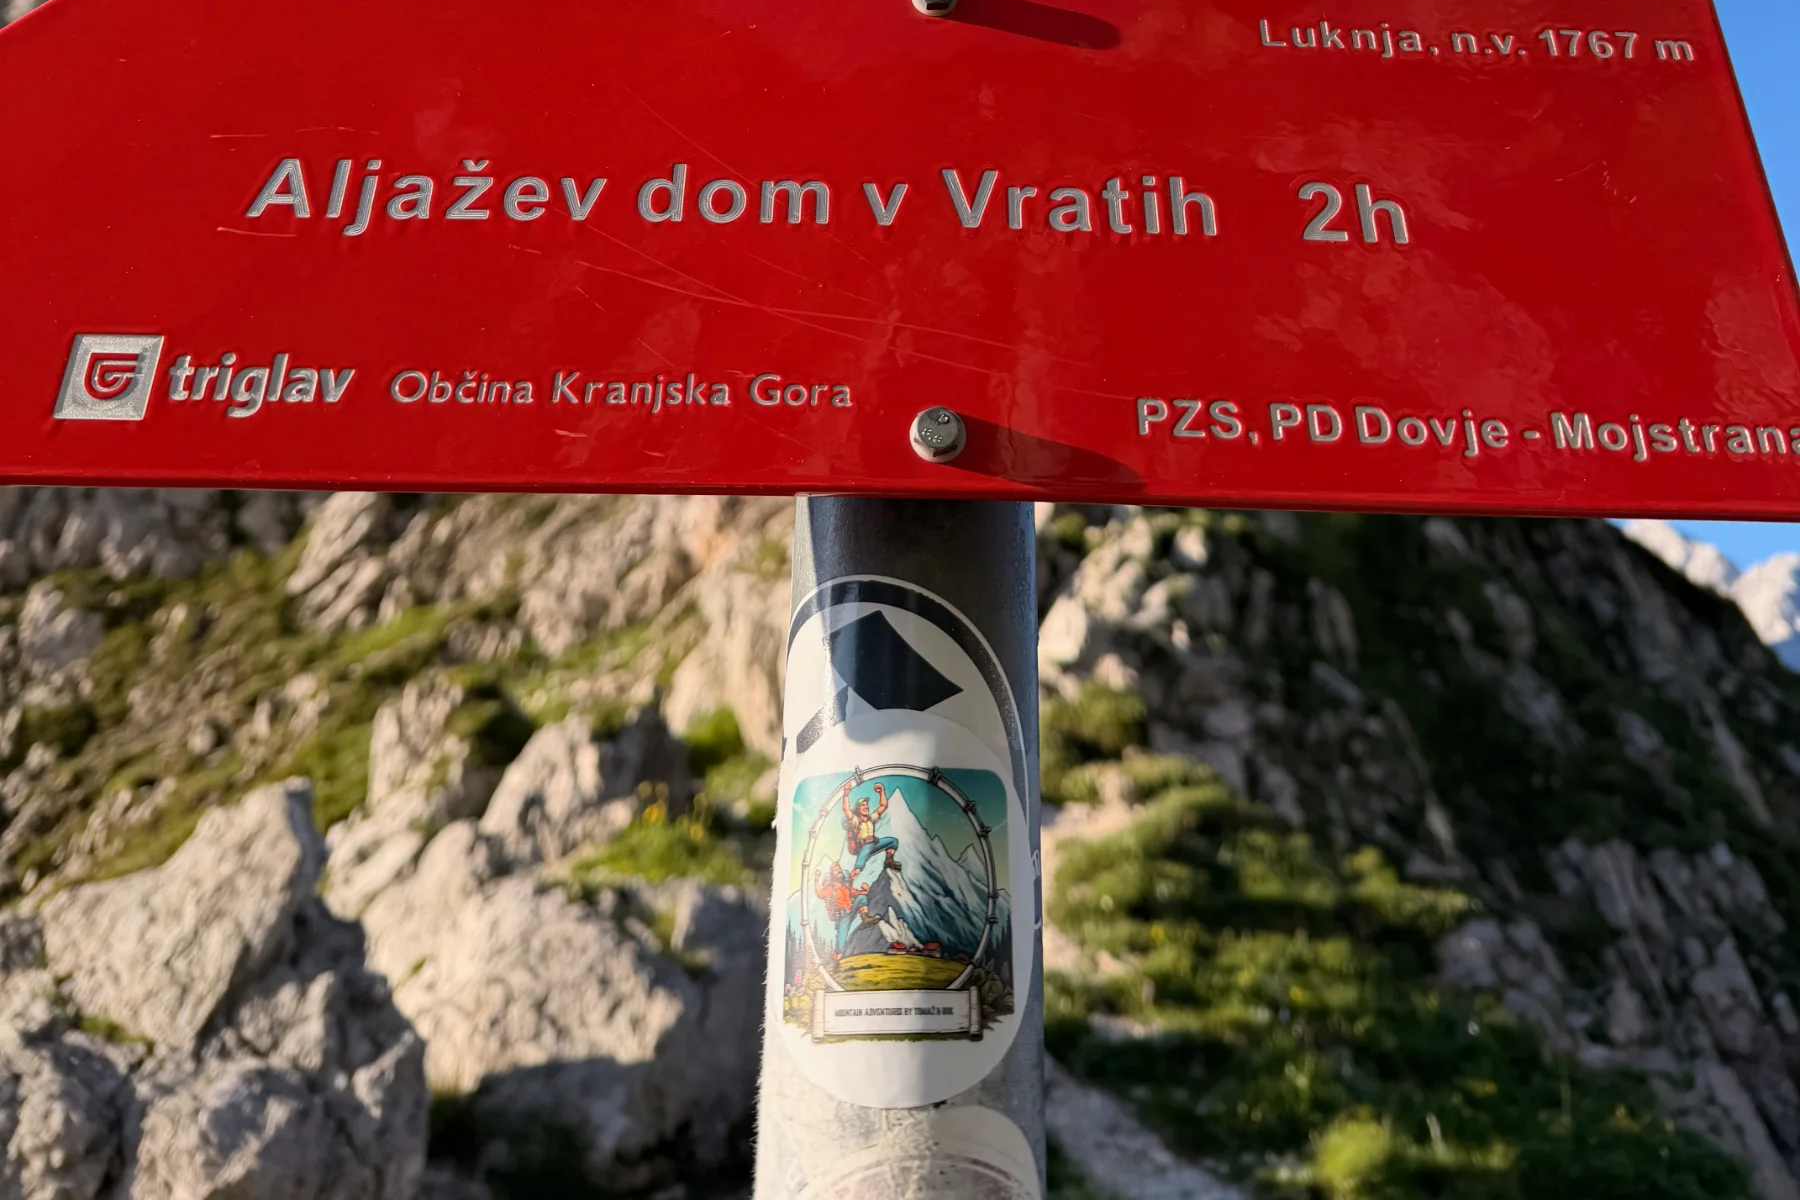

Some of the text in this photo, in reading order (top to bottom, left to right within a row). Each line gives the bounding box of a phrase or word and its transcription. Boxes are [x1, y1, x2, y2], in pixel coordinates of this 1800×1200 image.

[1260, 20, 1694, 61] Luknja, n.v. 1767 m
[247, 159, 1409, 244] Aljažev dom v Vratih 2h
[170, 353, 852, 418] triglav Občina Kranjska Gora
[1138, 399, 1258, 445] PZS,
[1271, 404, 1342, 442] PD
[1356, 407, 1509, 457] Dovje
